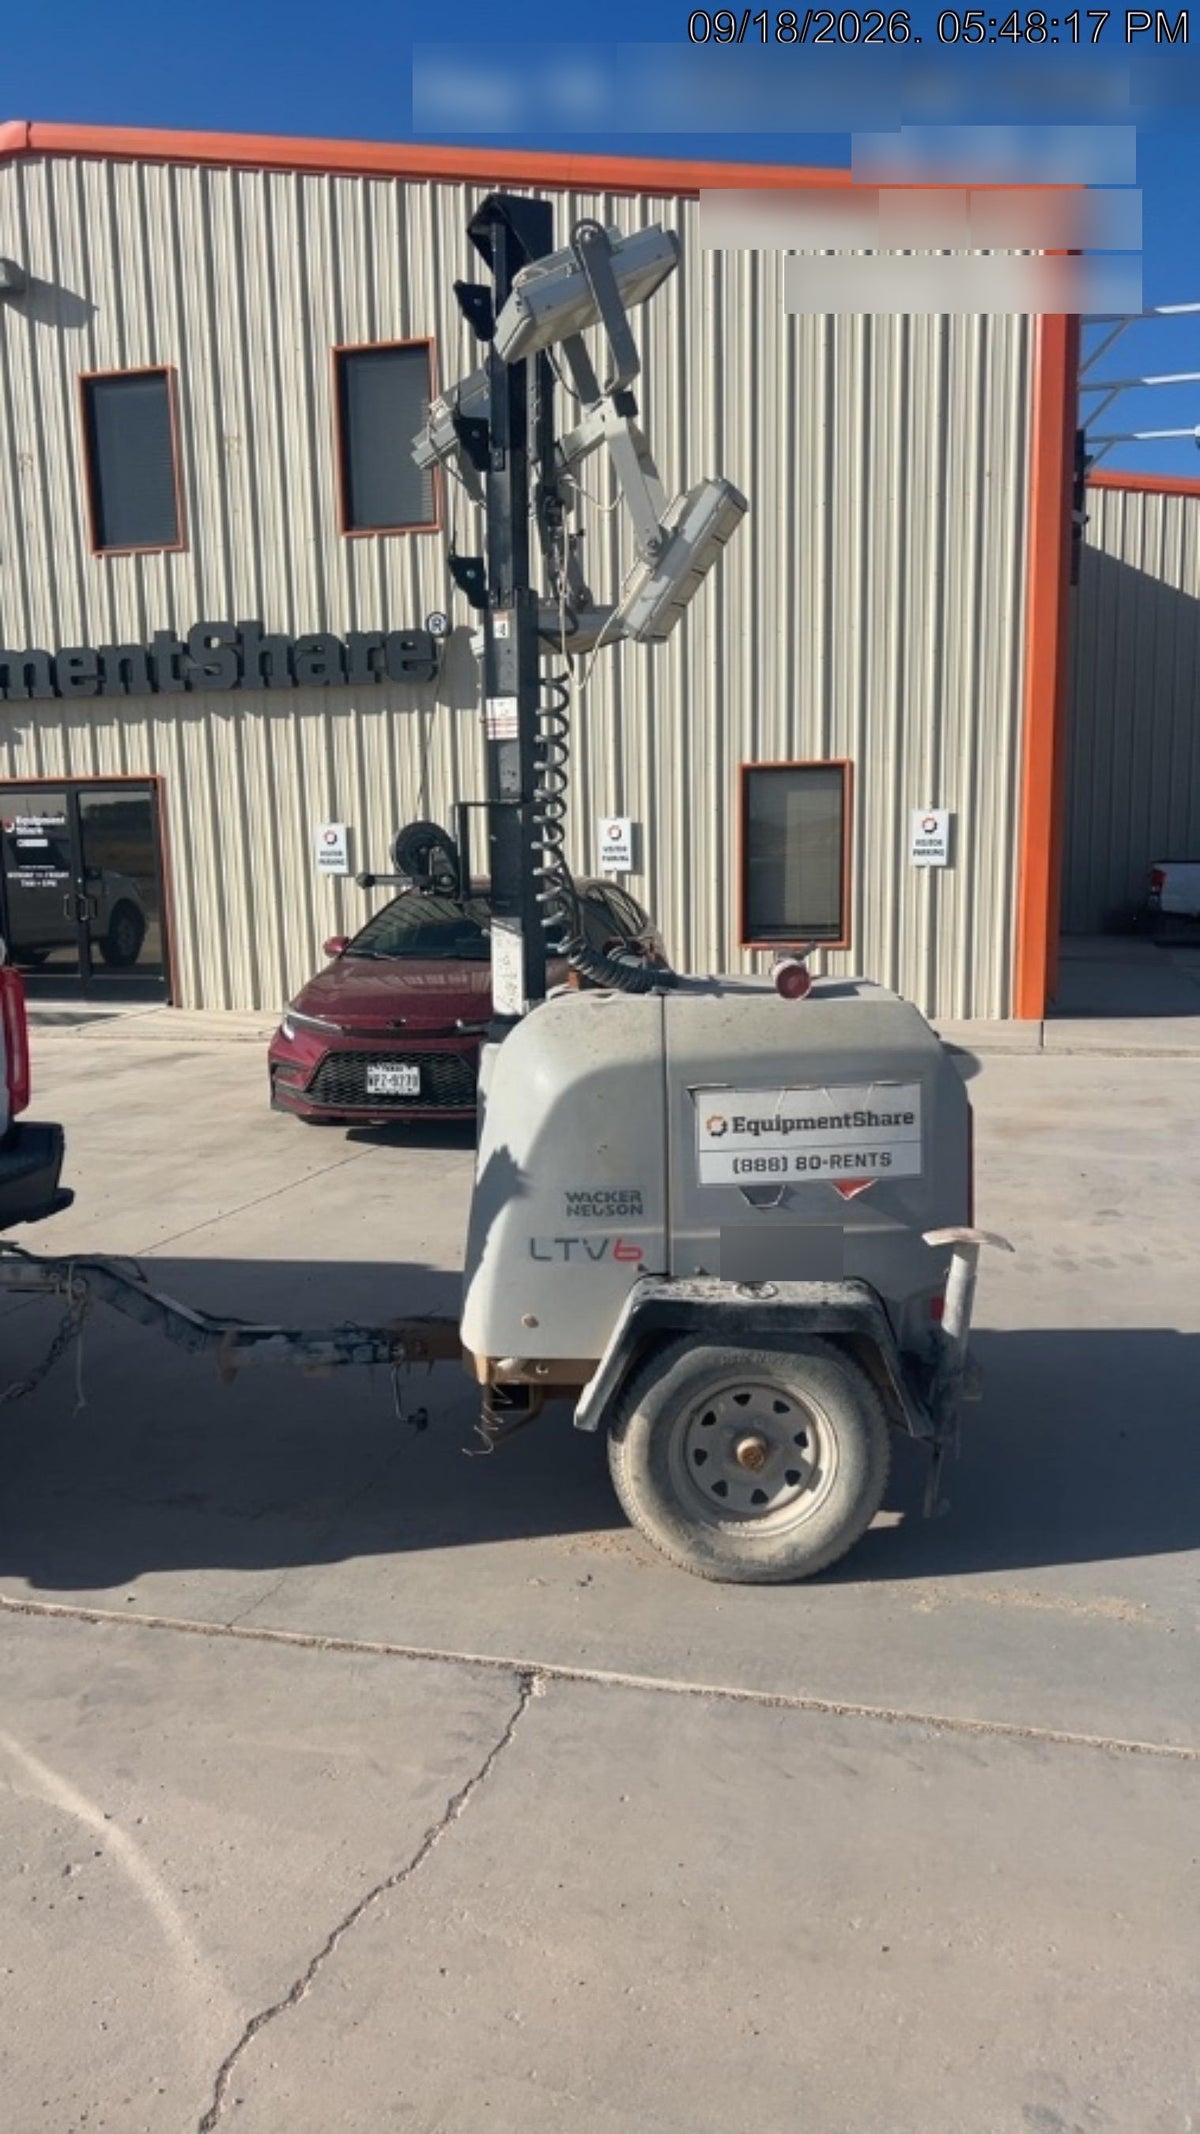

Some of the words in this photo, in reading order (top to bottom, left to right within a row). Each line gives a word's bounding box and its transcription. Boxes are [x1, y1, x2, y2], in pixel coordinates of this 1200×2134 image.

[732, 1111, 914, 1136] EquipmentShare
[732, 1156, 788, 1174] (888)
[795, 1151, 893, 1171] 80-RENTS
[564, 1190, 642, 1204] WACKER
[565, 1204, 644, 1217] NEUSON
[529, 1237, 644, 1262] LTV6
